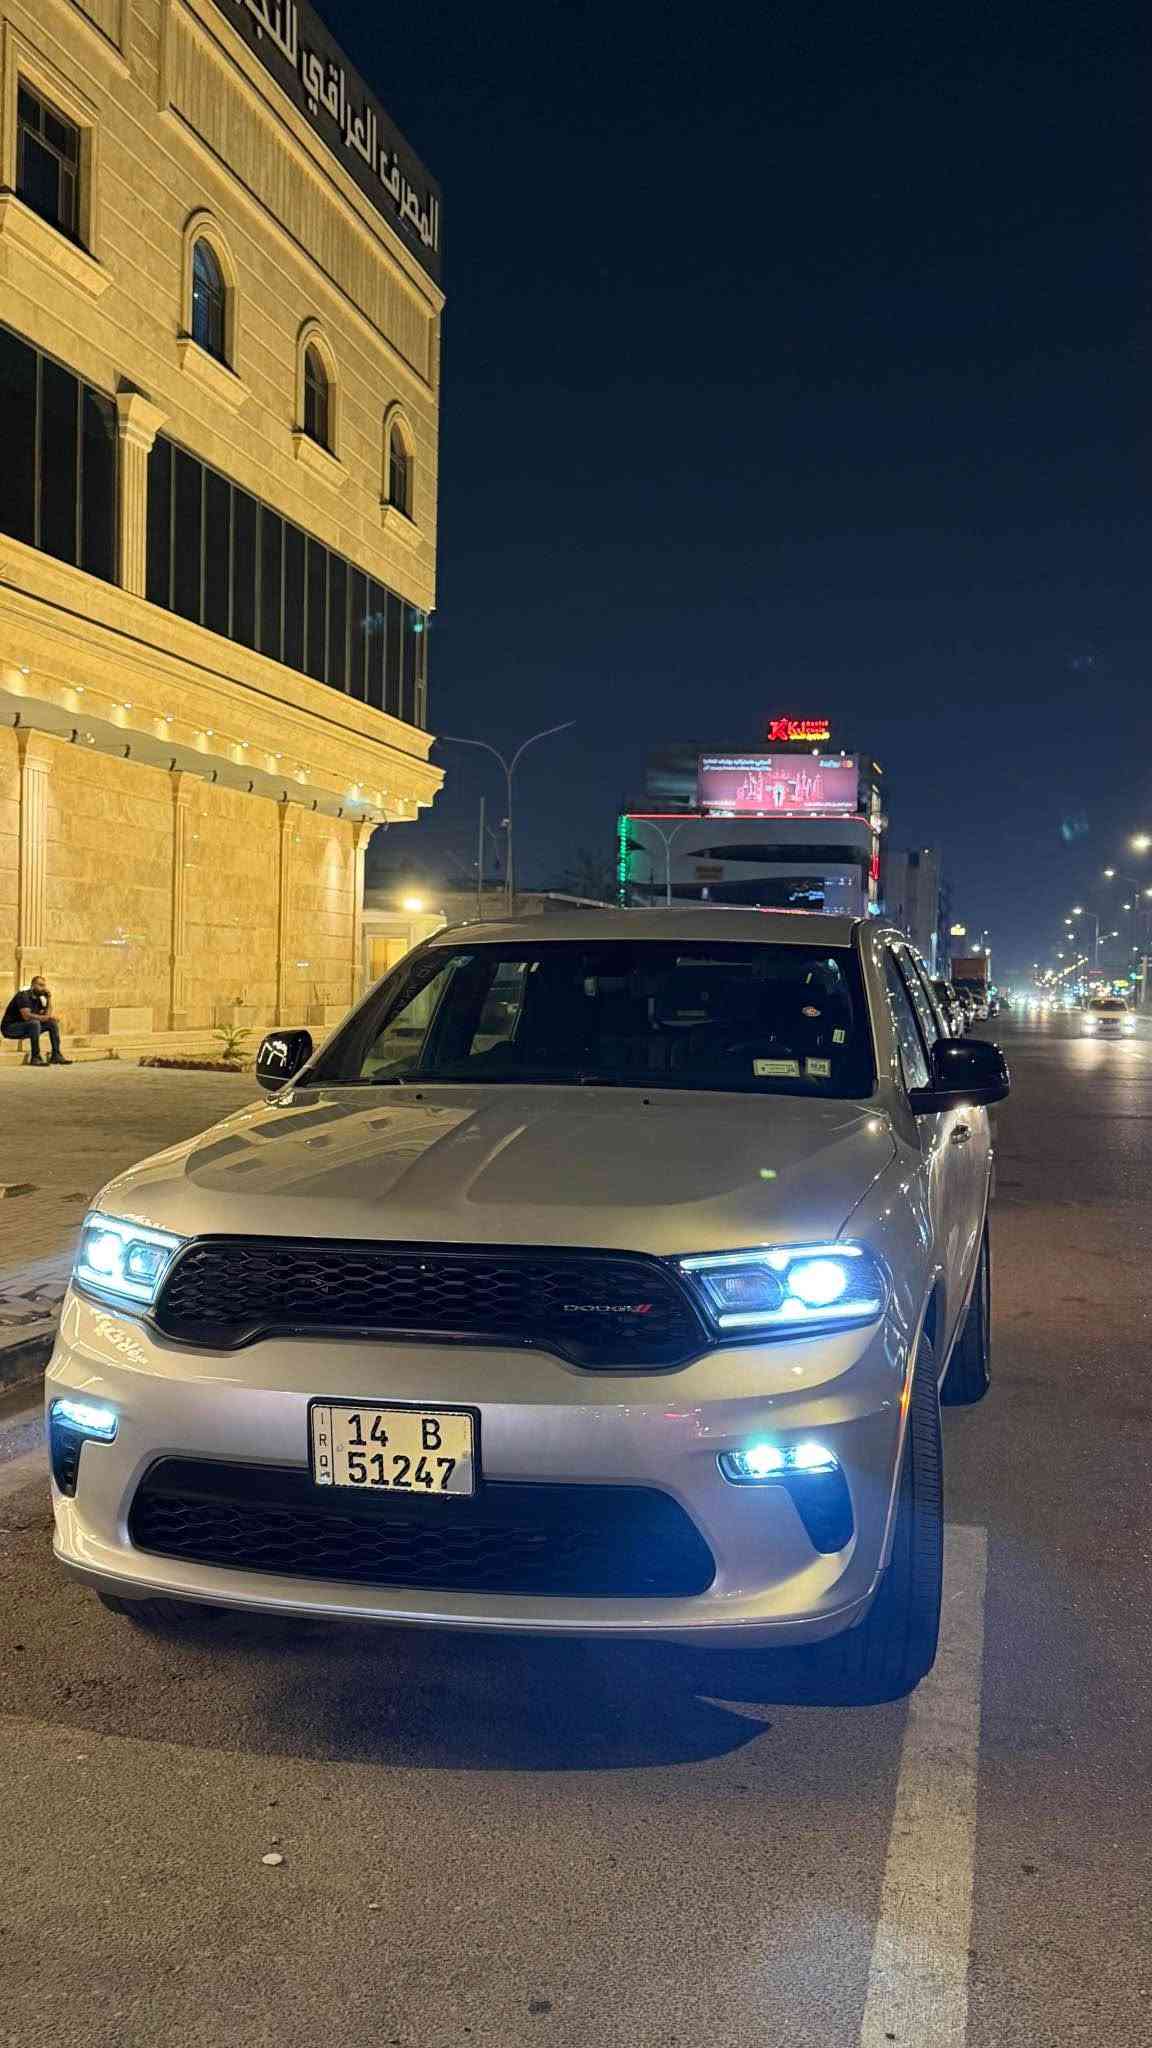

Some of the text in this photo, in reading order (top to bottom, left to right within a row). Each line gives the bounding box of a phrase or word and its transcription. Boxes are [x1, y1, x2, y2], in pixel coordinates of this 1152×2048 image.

[302, 51, 376, 173] العراقي
[380, 150, 438, 252] المصرف
[348, 1414, 442, 1450] 14 B
[347, 1451, 456, 1490] 51247
